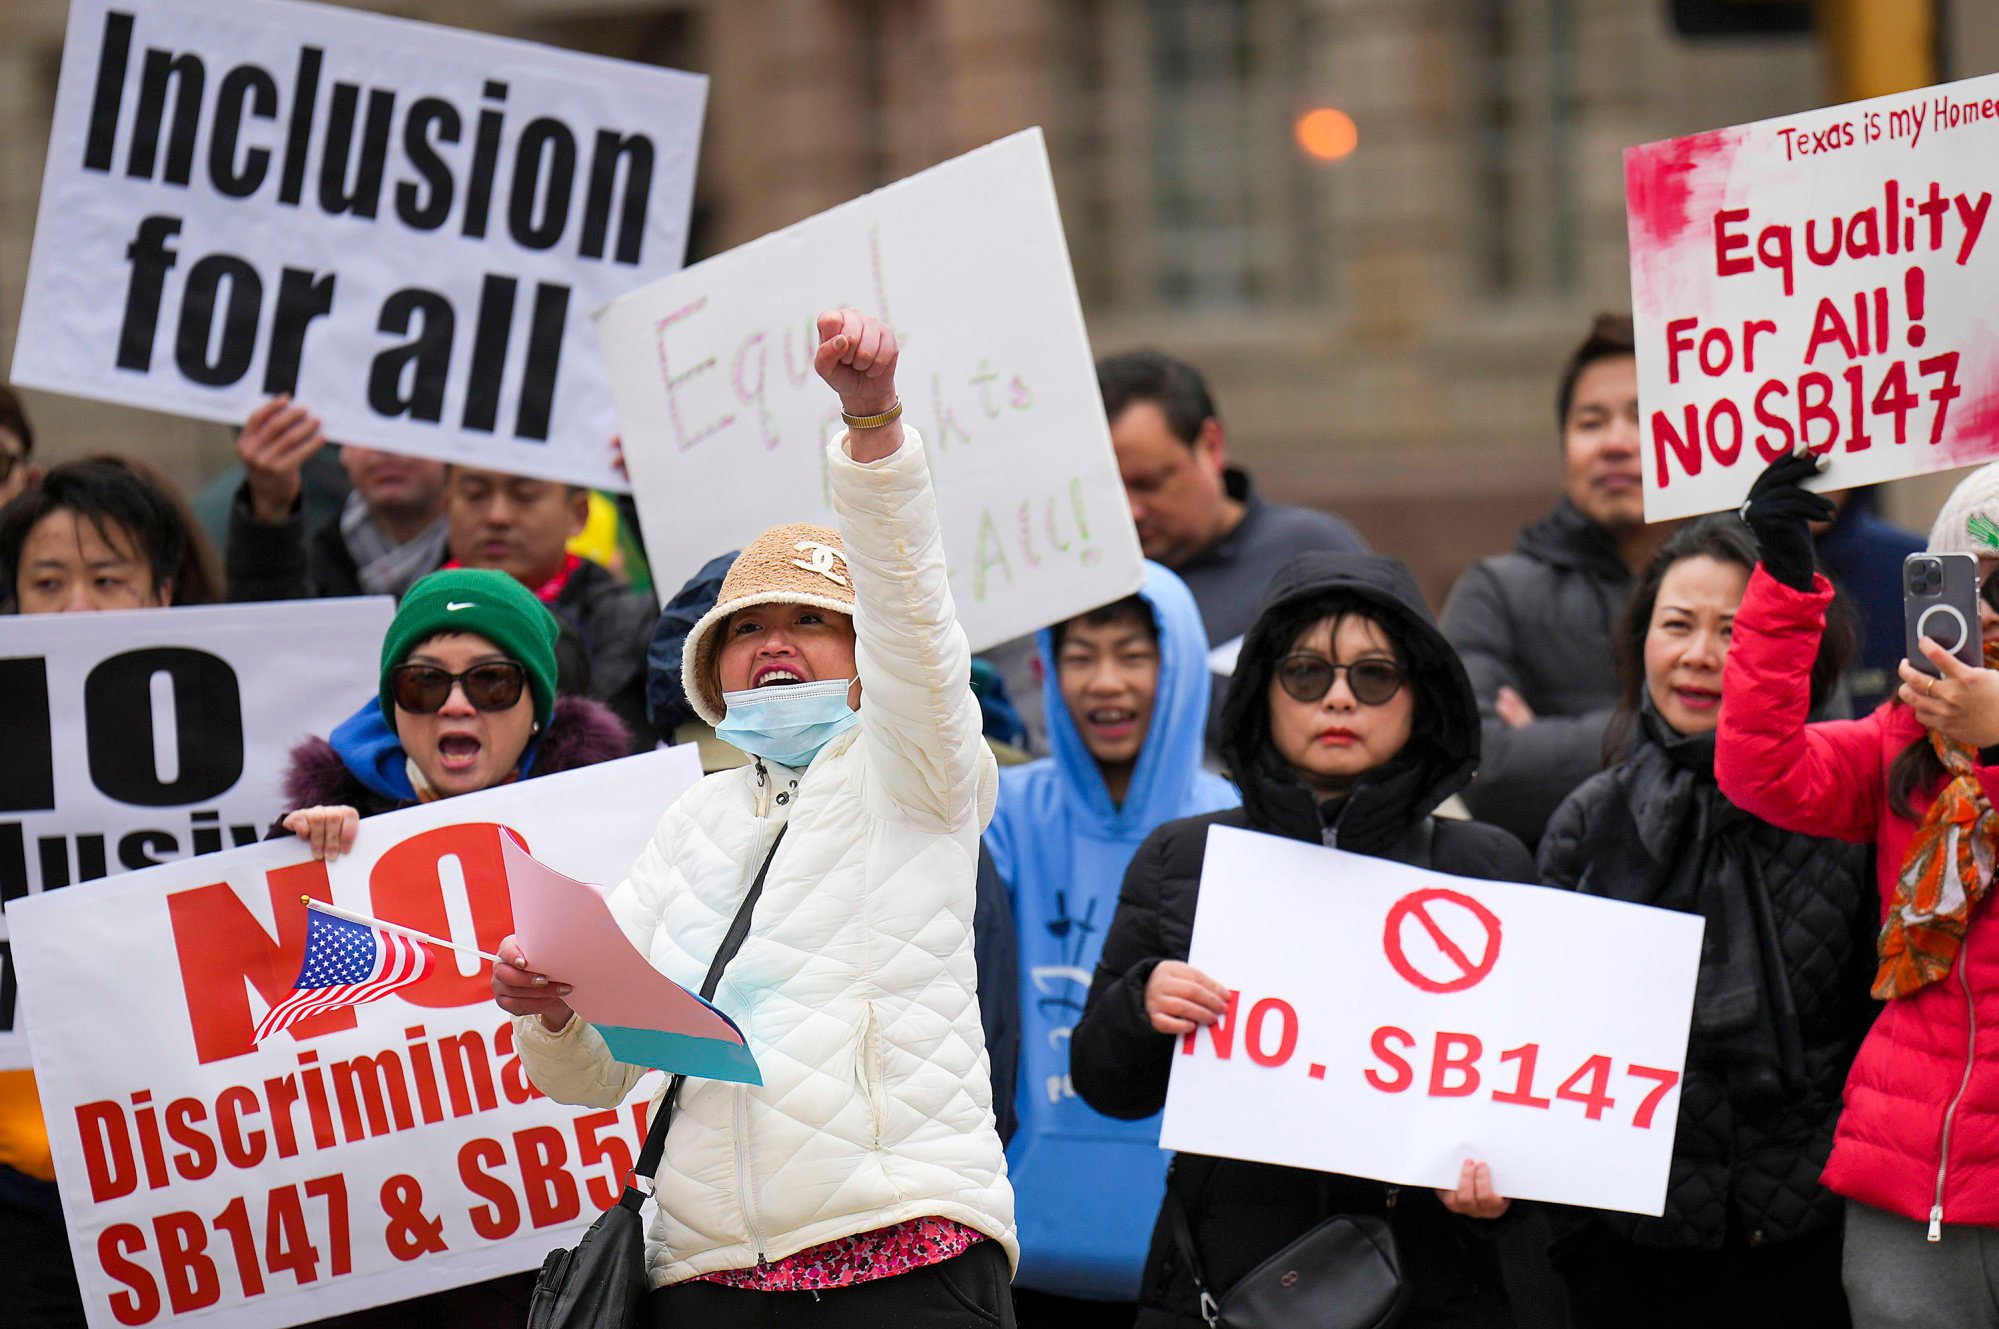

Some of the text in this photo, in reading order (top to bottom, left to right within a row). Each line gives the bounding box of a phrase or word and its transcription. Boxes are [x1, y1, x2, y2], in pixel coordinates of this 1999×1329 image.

[83, 11, 655, 265] Inclusion
[1776, 121, 1855, 161] Texas
[1864, 111, 1881, 145] is
[1889, 101, 1927, 149] my
[1713, 179, 1993, 297] Equality
[116, 214, 571, 442] for all
[654, 220, 906, 451] Equl
[1666, 265, 1927, 384] For All!
[1651, 350, 1963, 489] NO SB147
[972, 476, 1101, 602] All!
[167, 822, 532, 1065] NO
[1364, 1026, 1680, 1130] SB147
[97, 1100, 650, 1327] SB147 & SB5
